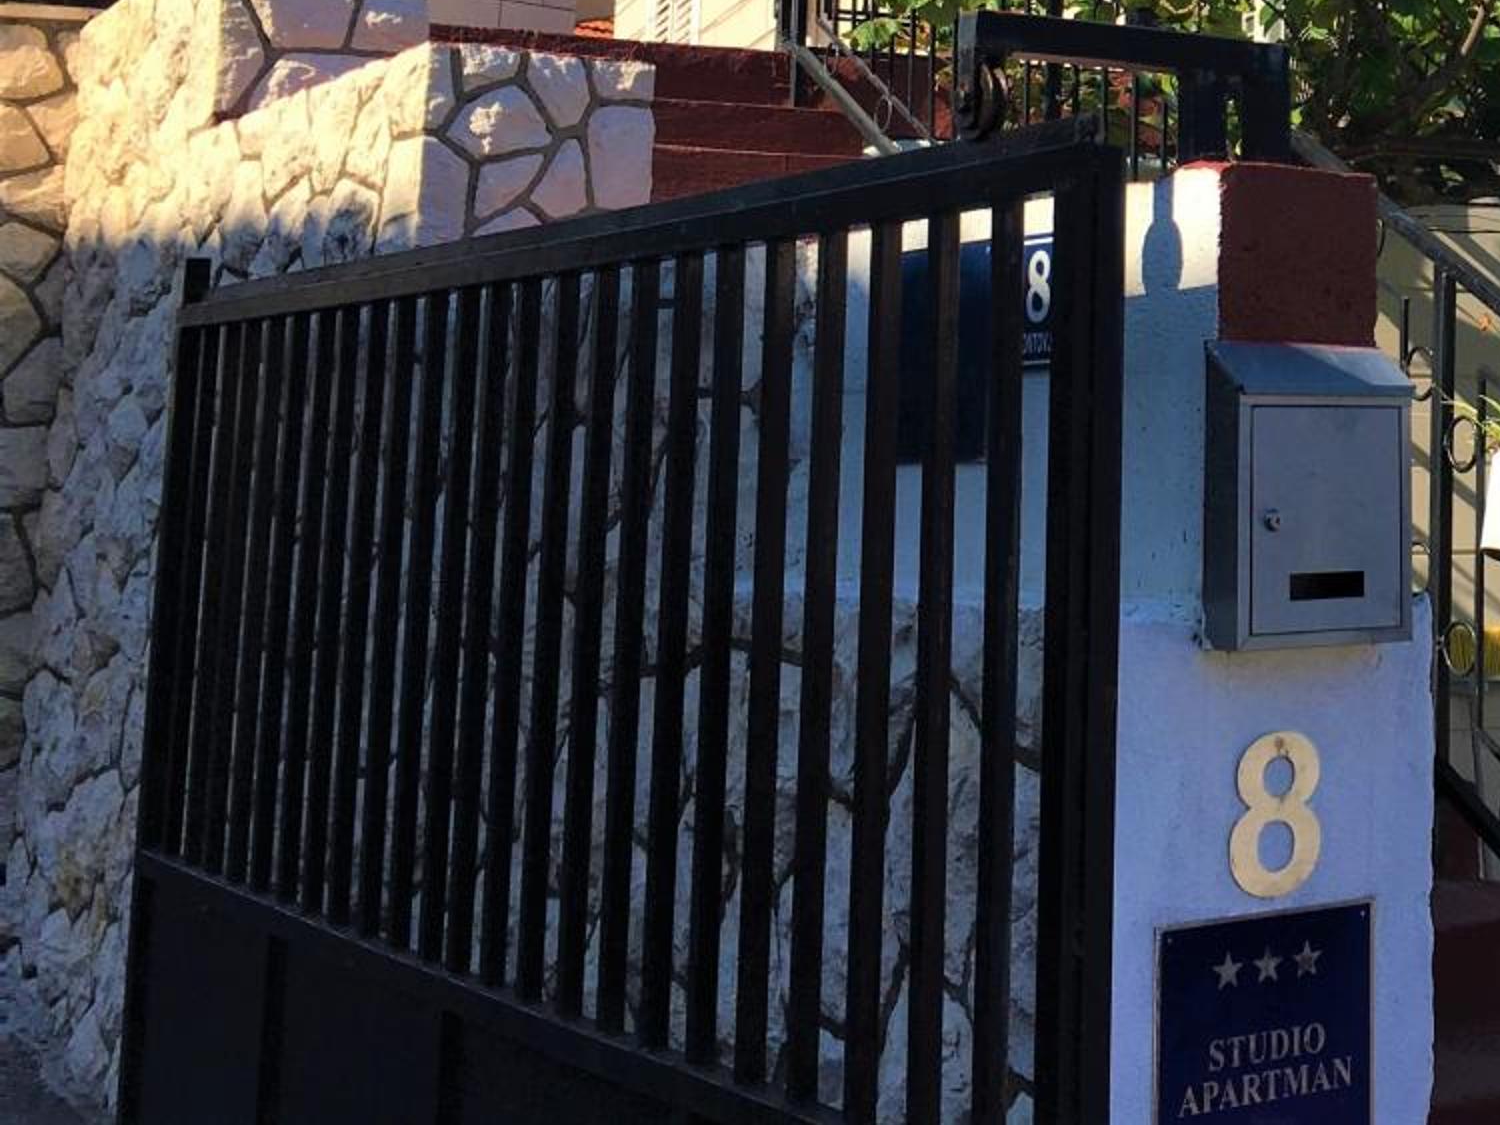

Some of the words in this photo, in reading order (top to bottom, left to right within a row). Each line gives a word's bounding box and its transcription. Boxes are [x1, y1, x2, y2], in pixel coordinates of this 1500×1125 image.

[1025, 249, 1051, 323] 8
[1229, 730, 1322, 898] 8
[1208, 1021, 1326, 1073] STUDIO
[1177, 1055, 1353, 1118] APARTMAN
